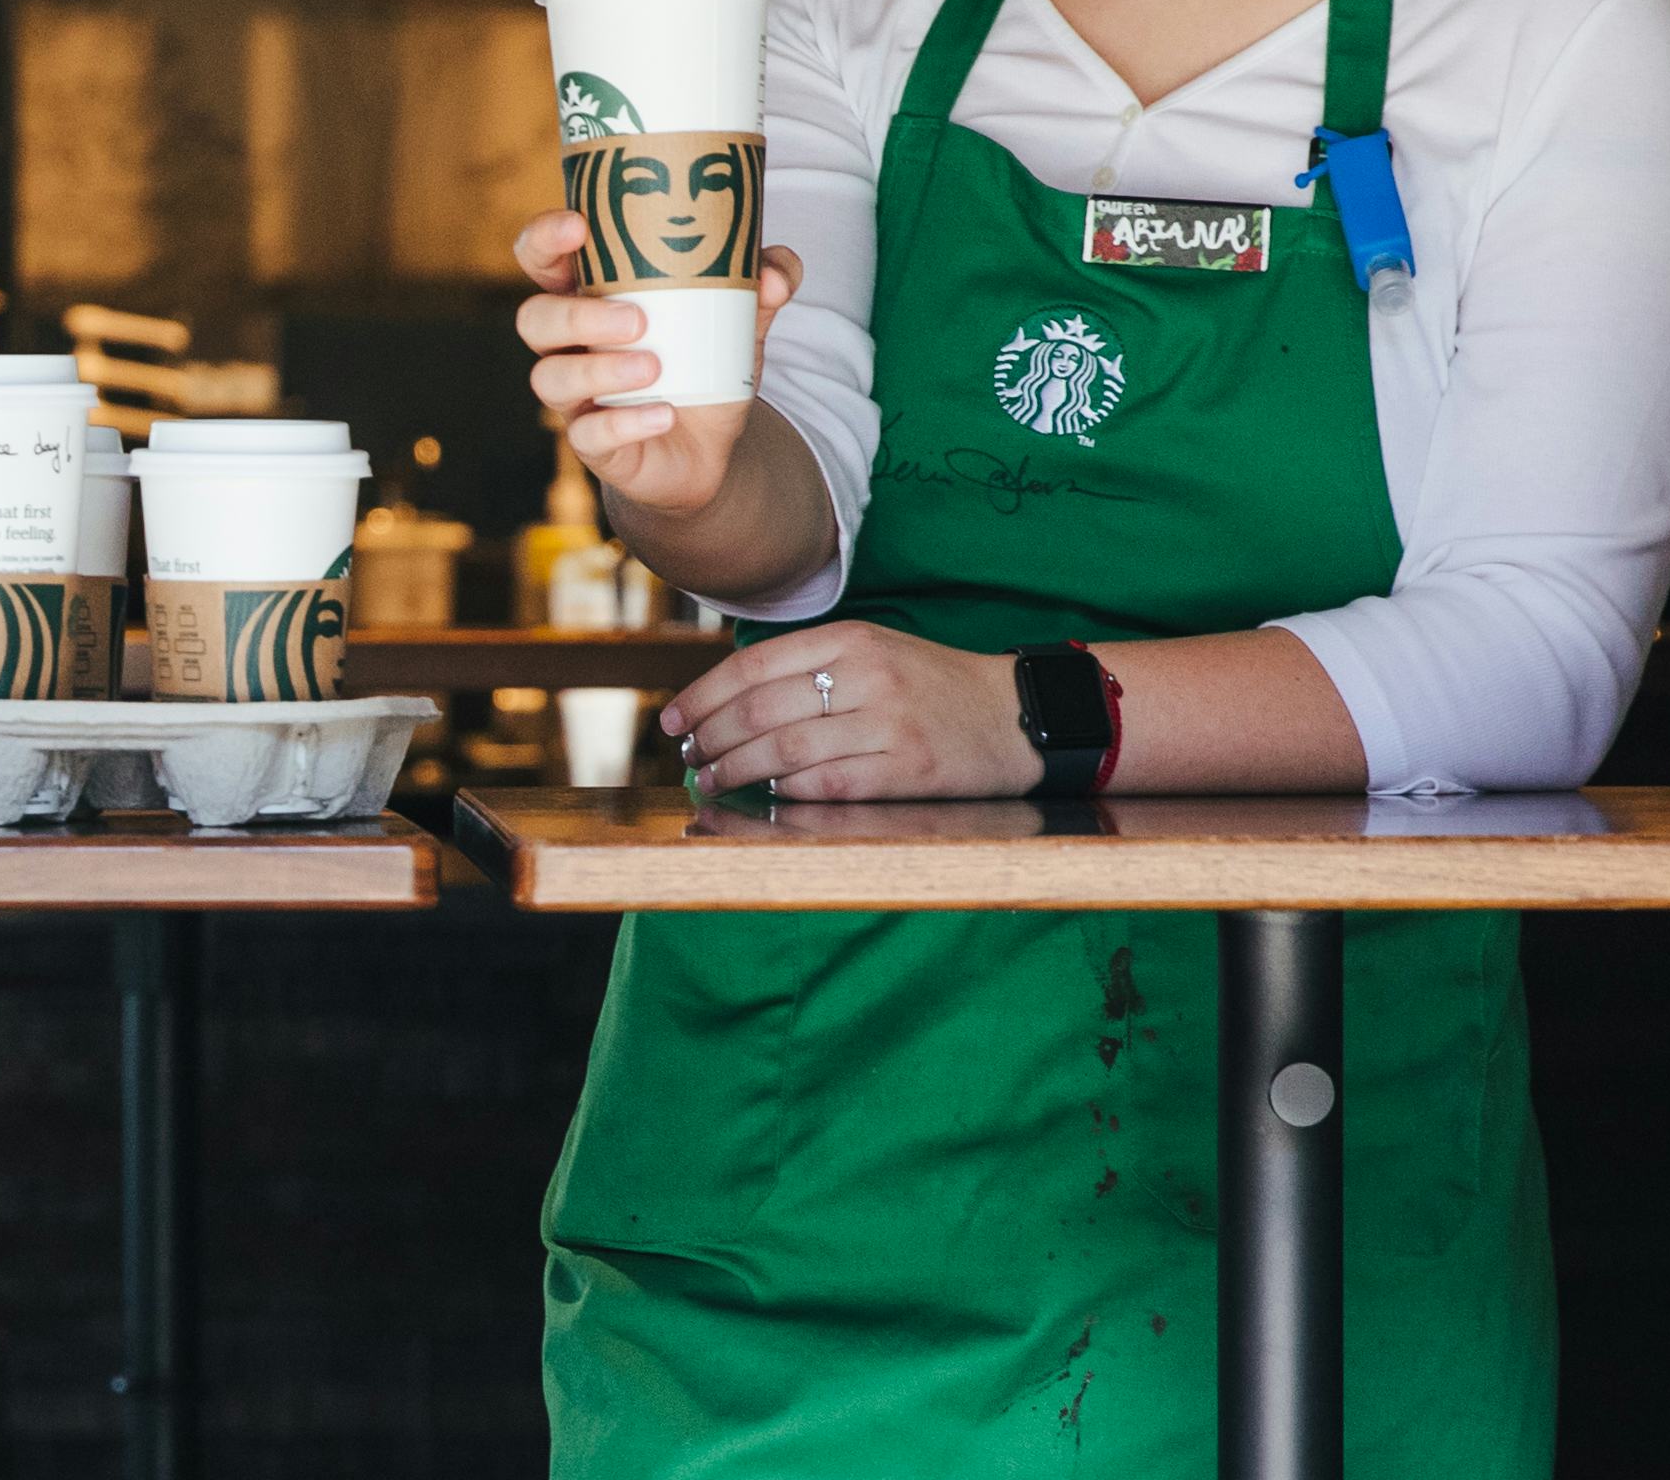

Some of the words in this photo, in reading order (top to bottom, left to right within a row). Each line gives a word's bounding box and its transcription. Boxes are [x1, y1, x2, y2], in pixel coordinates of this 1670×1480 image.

[1097, 200, 1156, 216] QUEEN
[1112, 214, 1251, 255] ARIANA
[34, 425, 71, 474] day!
[23, 504, 51, 519] first
[174, 558, 201, 573] first
